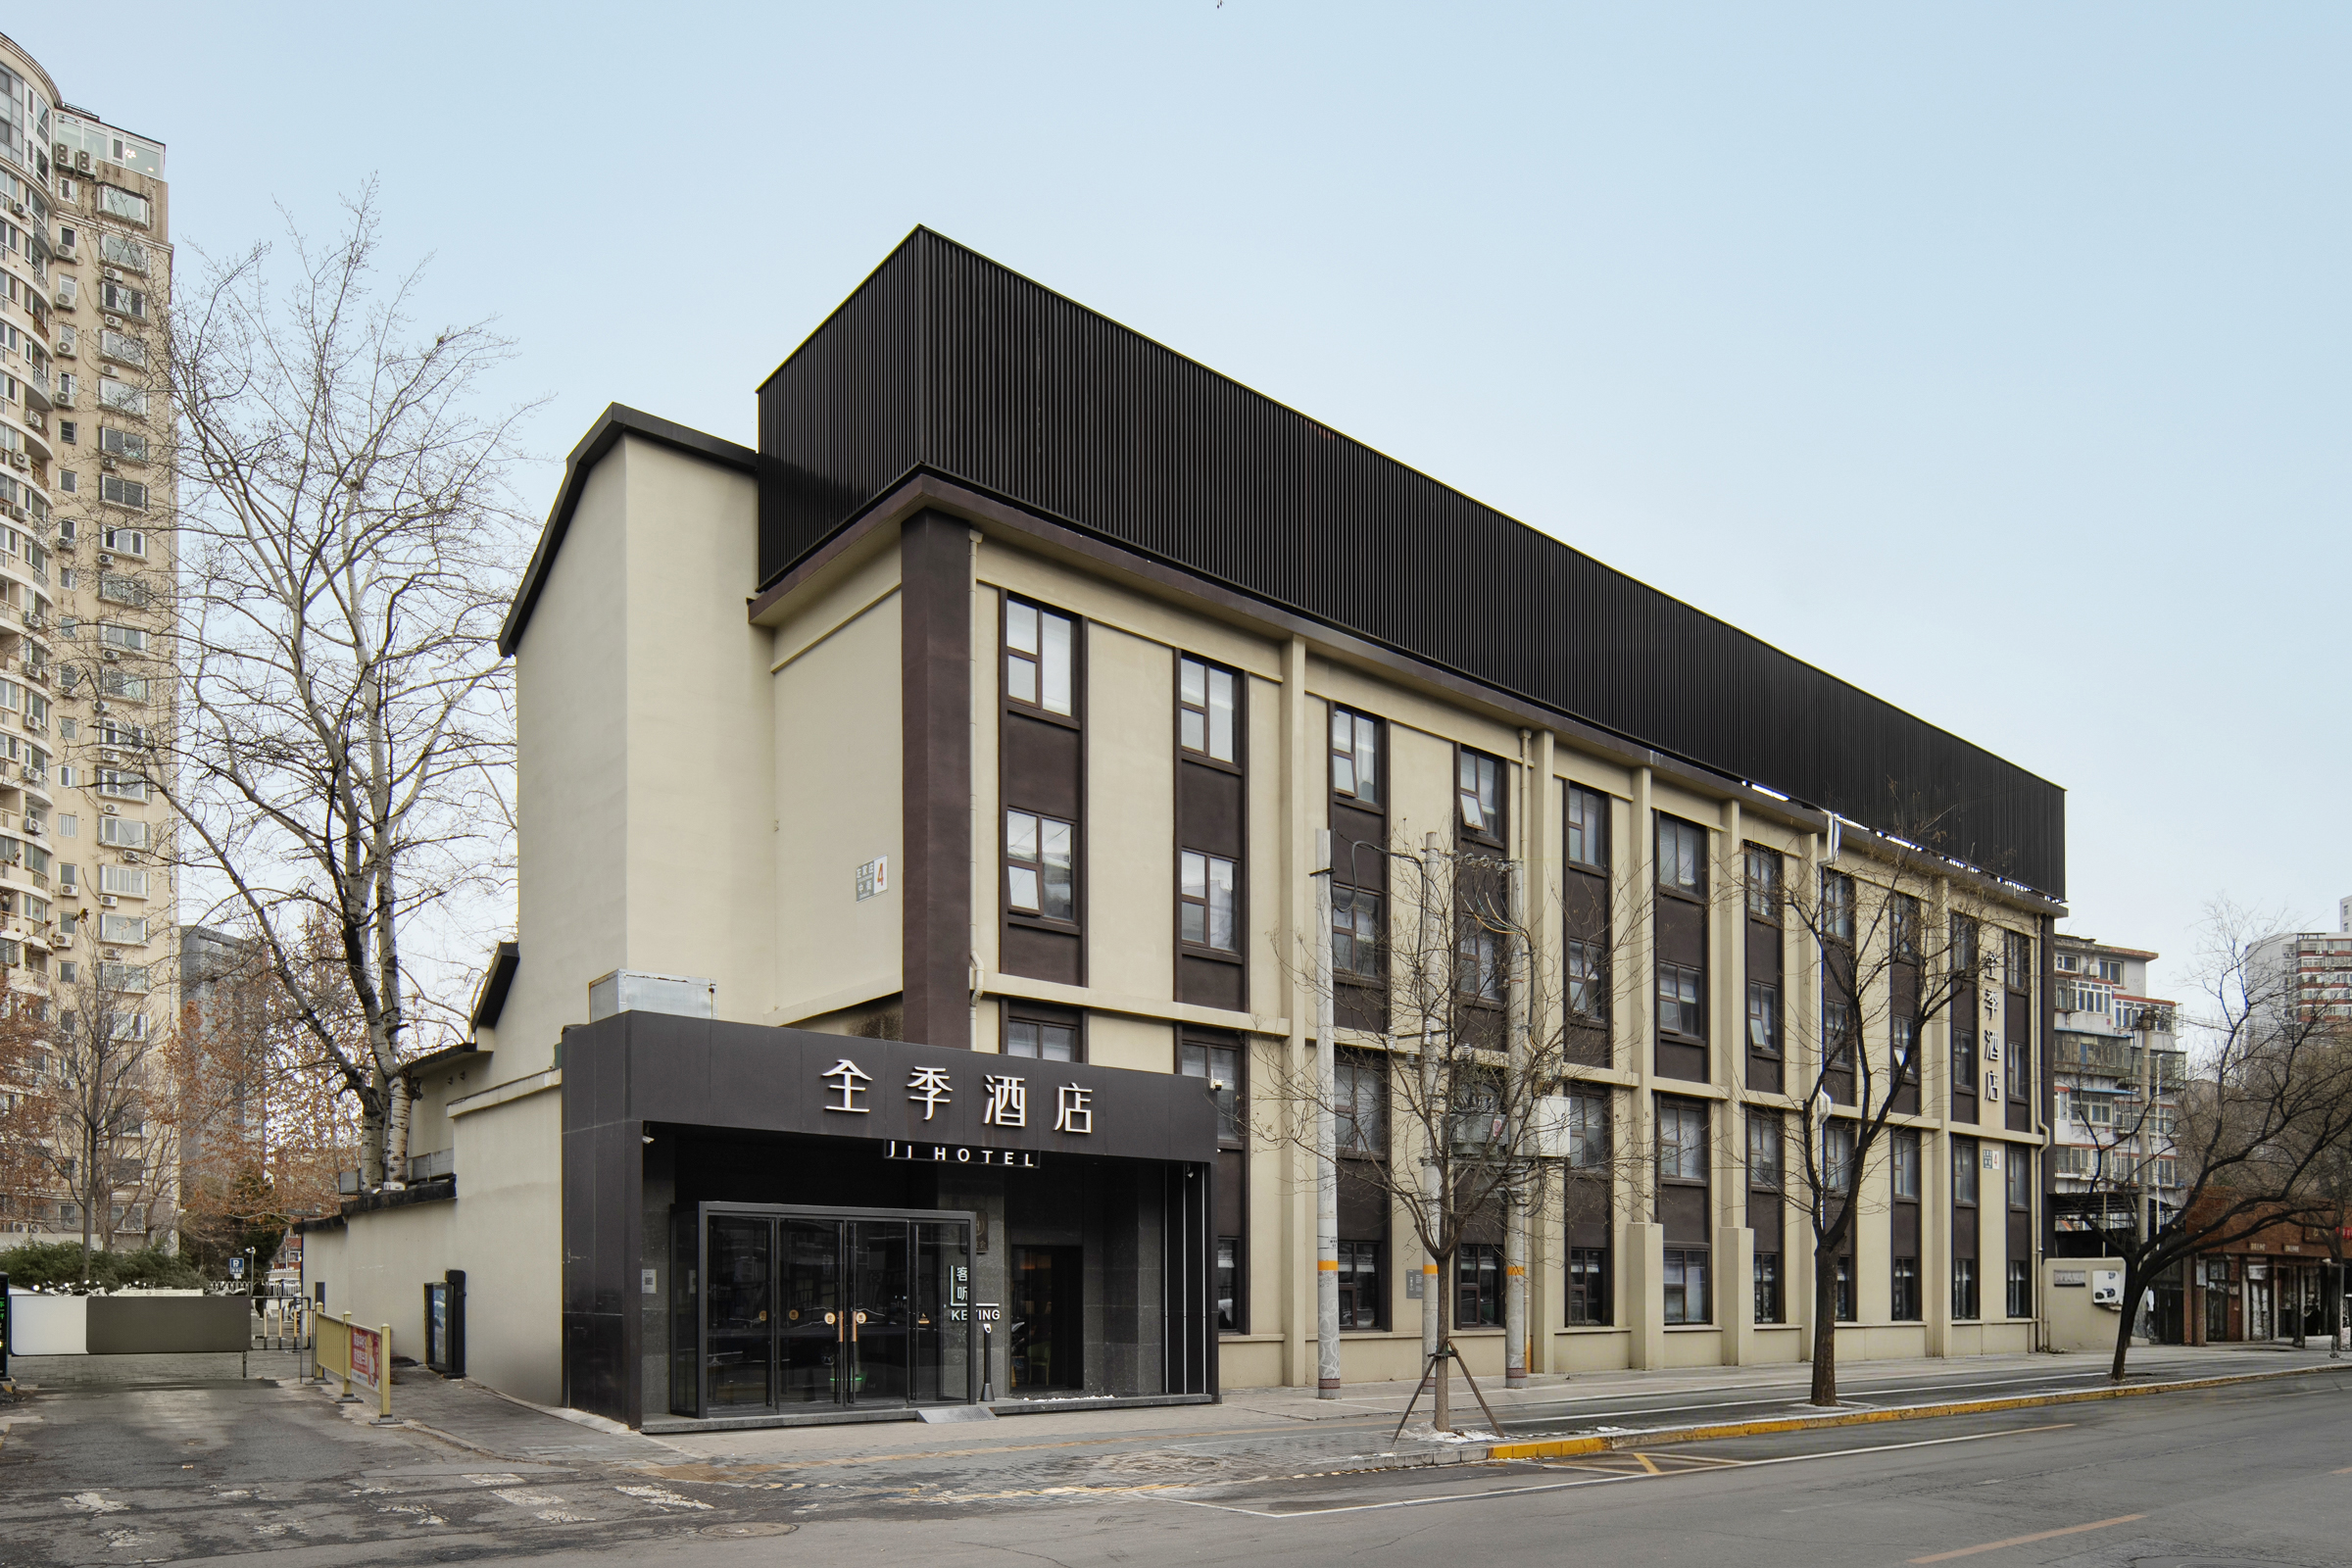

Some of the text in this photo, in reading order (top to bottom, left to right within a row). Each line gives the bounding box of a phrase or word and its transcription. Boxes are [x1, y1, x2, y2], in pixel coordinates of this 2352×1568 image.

[877, 862, 884, 886] 4
[1984, 951, 1999, 1102] 全季酒店
[821, 1058, 1094, 1134] 全季酒店
[889, 1141, 1034, 1167] JI HOTEL
[951, 1309, 1001, 1321] KEING
